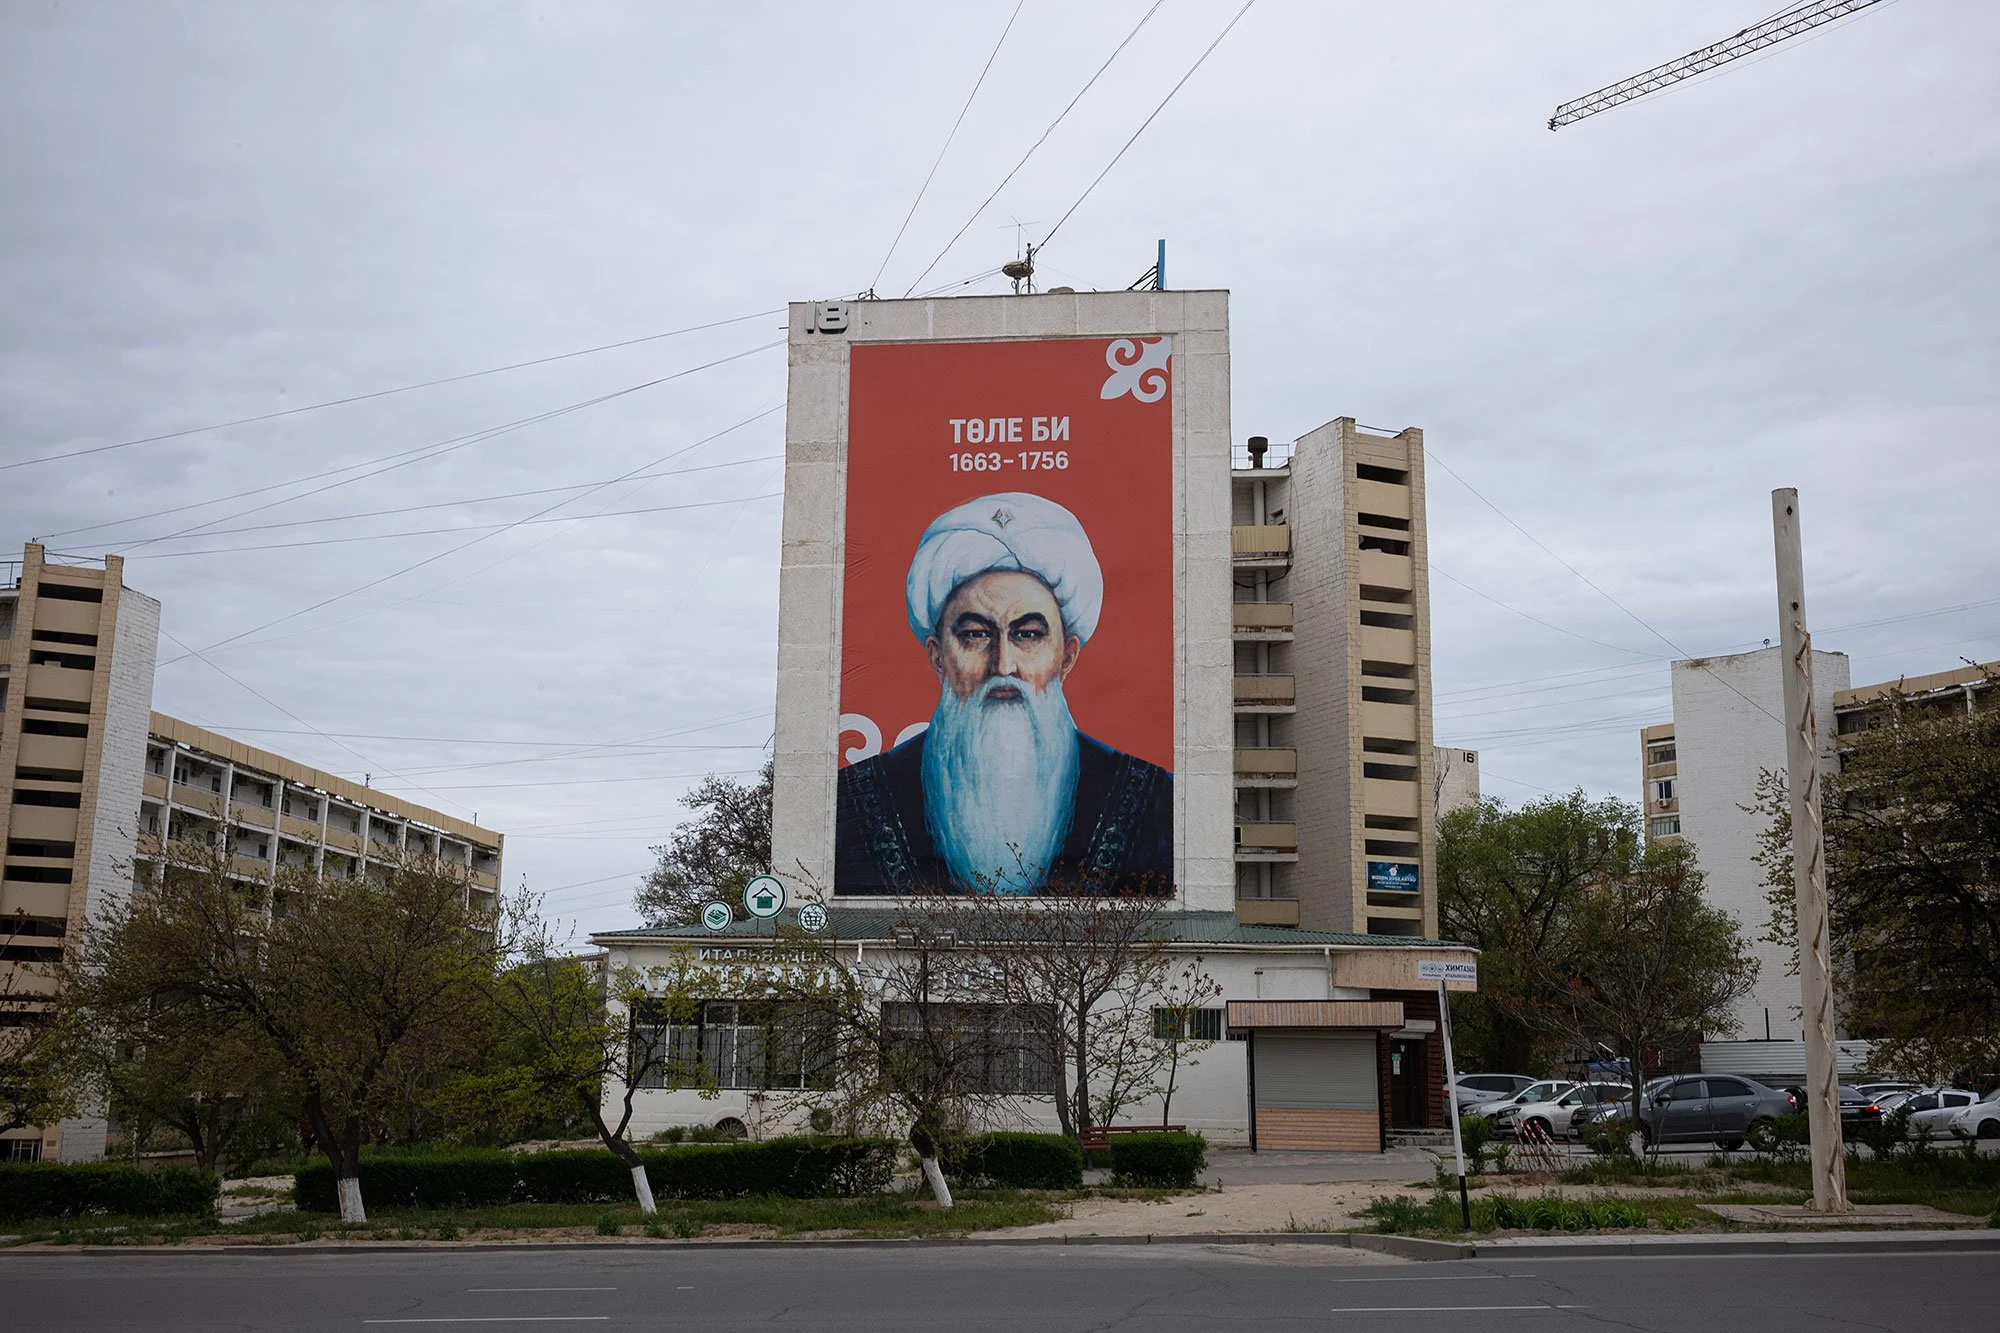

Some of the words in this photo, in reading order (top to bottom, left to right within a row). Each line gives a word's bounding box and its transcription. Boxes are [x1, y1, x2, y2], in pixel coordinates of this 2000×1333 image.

[804, 300, 849, 334] 18
[949, 418, 1023, 443] ТӨЛЕ
[1032, 416, 1070, 441] БИ
[1463, 752, 1475, 763] 16
